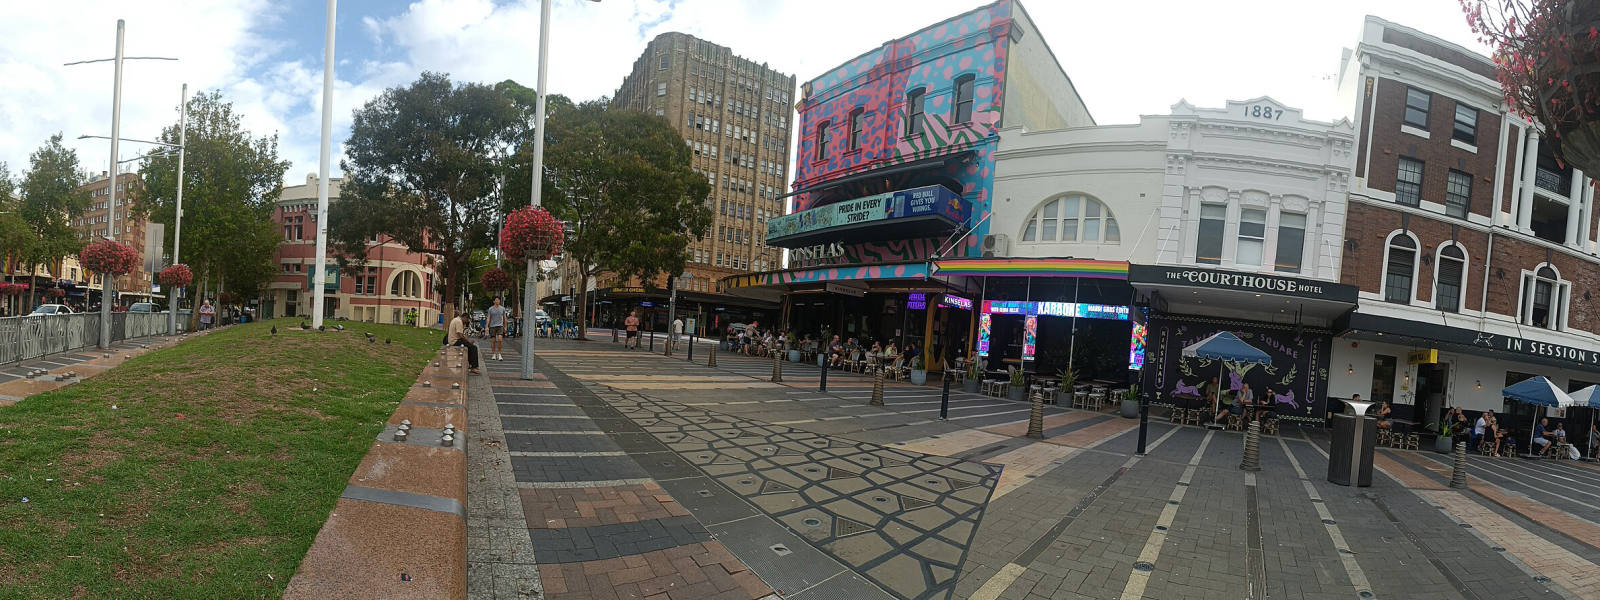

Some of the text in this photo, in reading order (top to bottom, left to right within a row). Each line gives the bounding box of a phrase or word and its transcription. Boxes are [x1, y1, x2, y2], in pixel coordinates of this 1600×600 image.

[1244, 105, 1283, 121] 1887
[838, 197, 882, 214] PRIDE IN EVERY
[846, 210, 870, 223] STRIDE?
[789, 240, 845, 262] KINSELAS
[1166, 270, 1323, 295] THE COURTHOUSE HOTEL
[944, 296, 971, 308] KINSELAS
[1037, 301, 1081, 317] KARAOKE
[1182, 329, 1298, 359] TAYLO SQUARE
[1507, 338, 1600, 365] IN SESSION S
[1157, 330, 1166, 384] KINSELAS
[1309, 343, 1318, 398] COURTHOUSE
